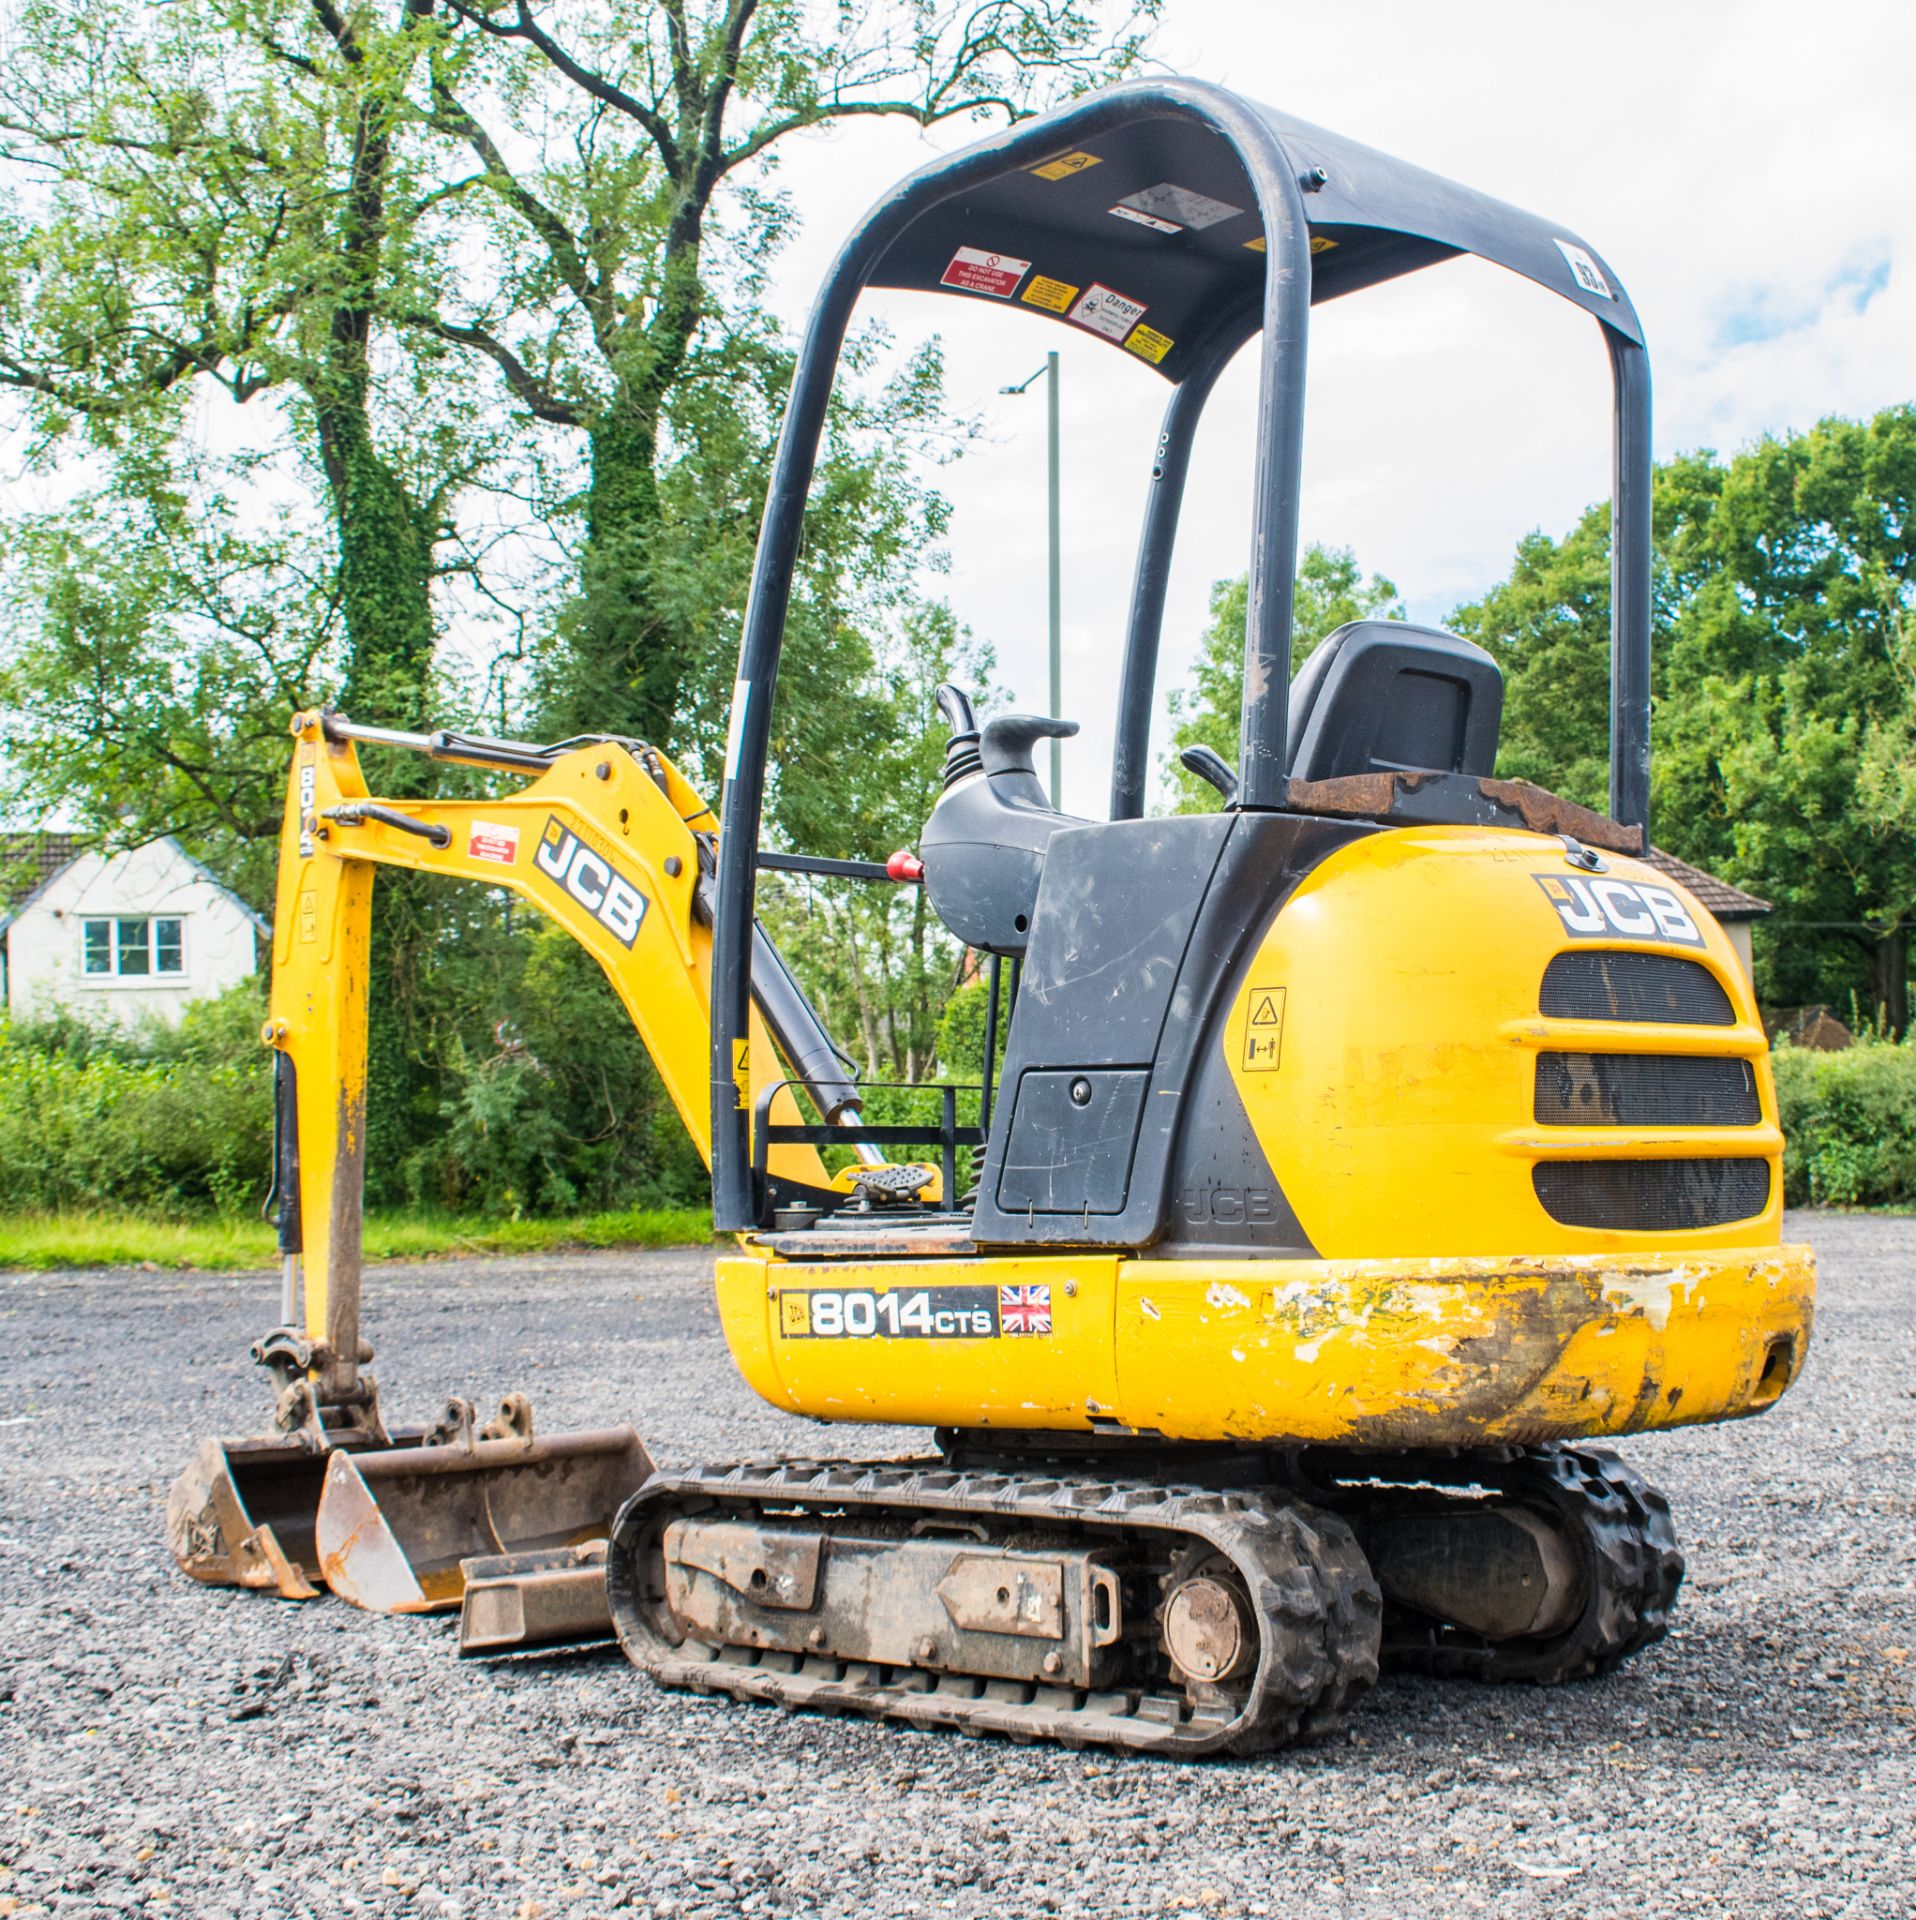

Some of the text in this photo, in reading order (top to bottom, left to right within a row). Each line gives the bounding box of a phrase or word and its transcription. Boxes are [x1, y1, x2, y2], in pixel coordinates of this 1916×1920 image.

[1105, 294, 1143, 316] Danger
[538, 834, 645, 941] JCB
[1558, 878, 1699, 941] JCB
[1183, 1187, 1281, 1225] JCB
